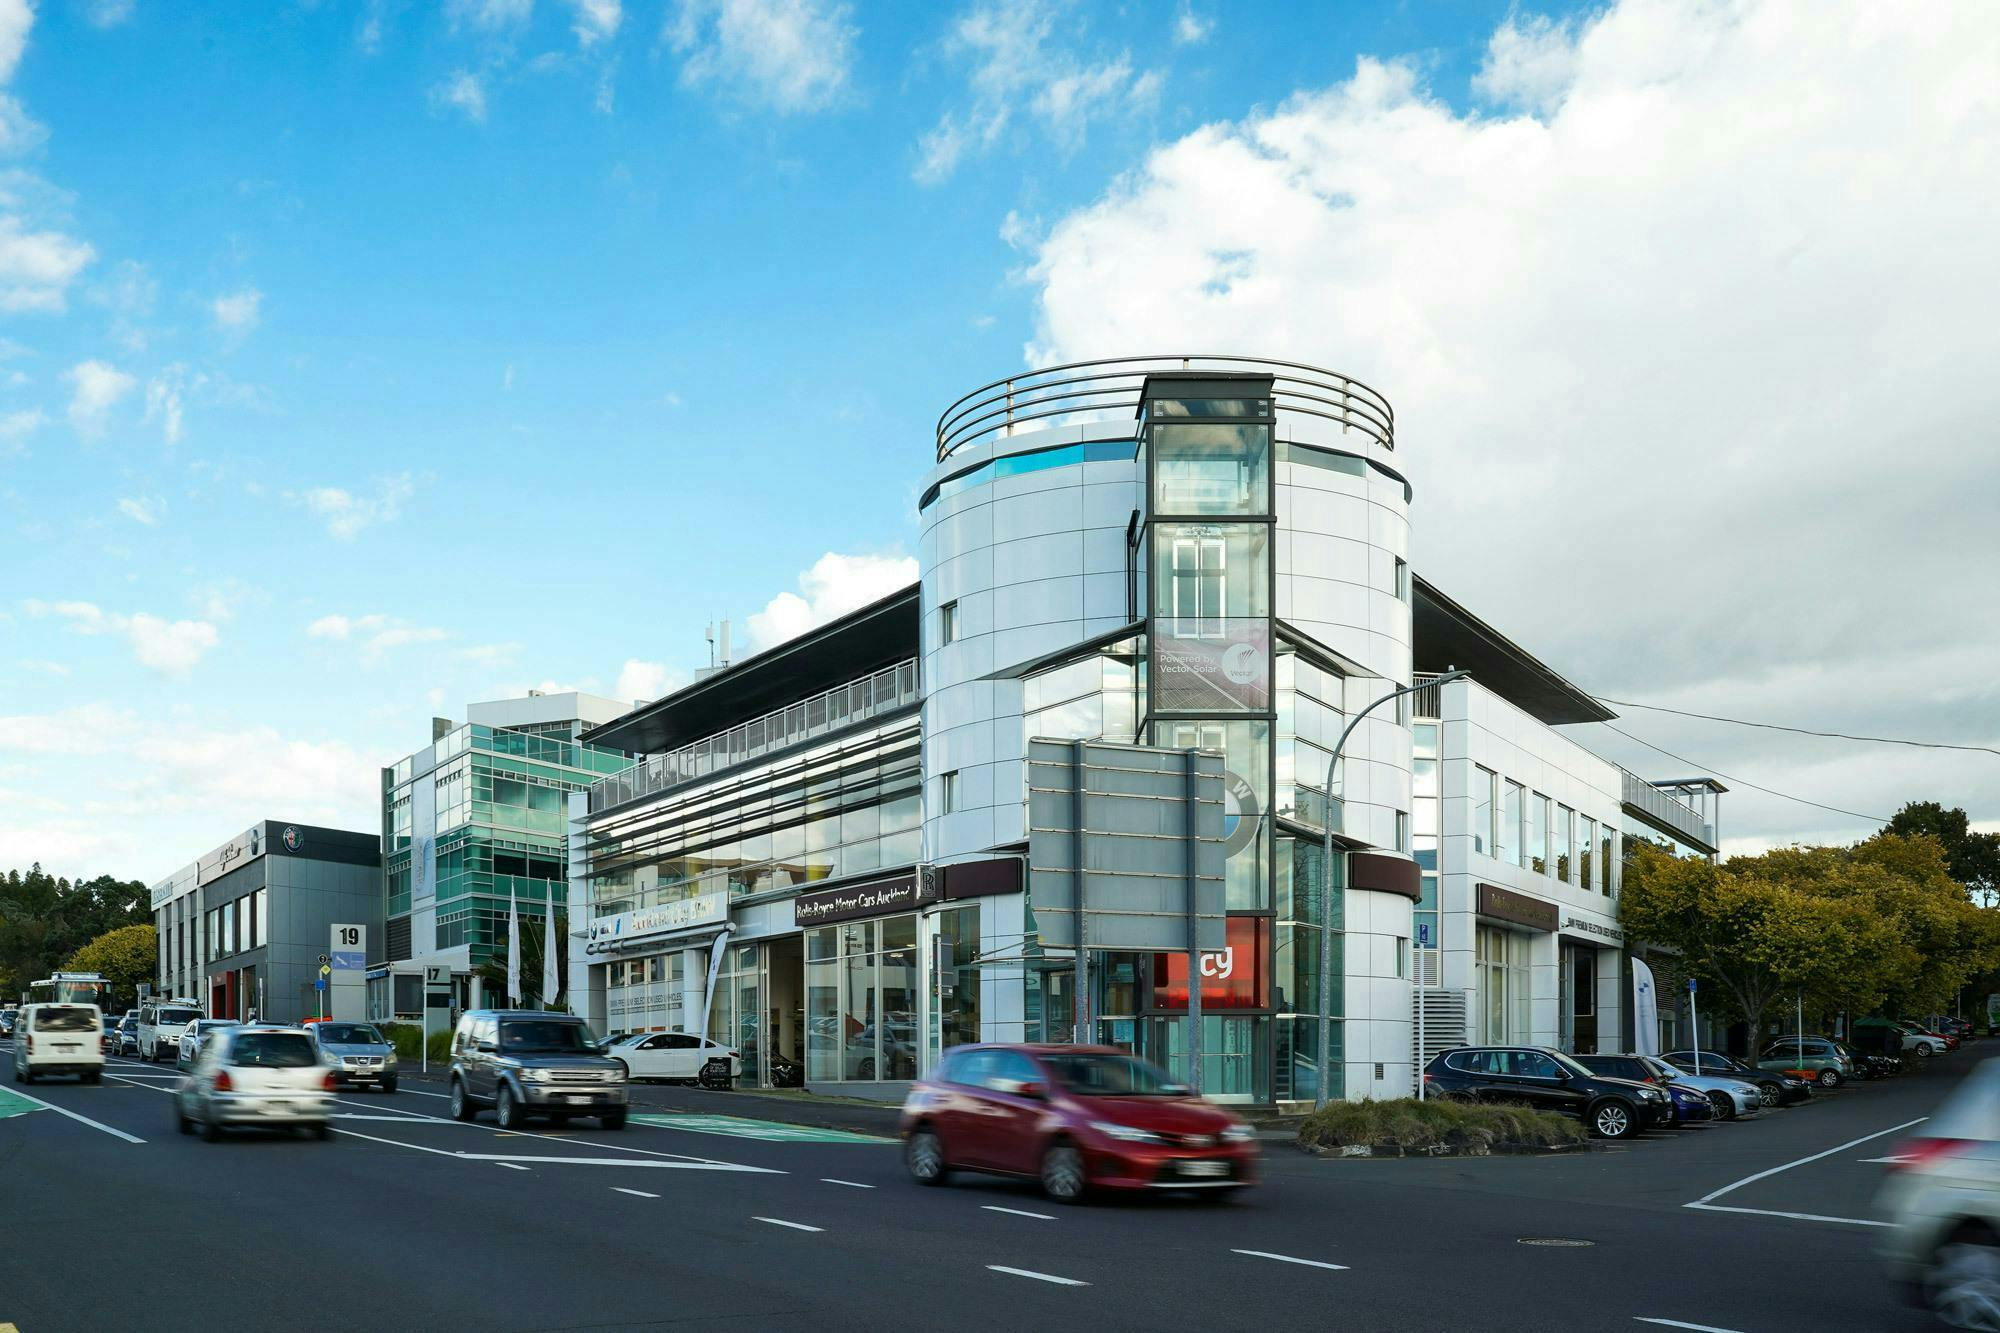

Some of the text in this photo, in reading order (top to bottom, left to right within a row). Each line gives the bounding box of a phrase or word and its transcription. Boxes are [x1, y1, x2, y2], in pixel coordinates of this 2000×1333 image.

[1160, 654, 1216, 664] Powered by
[1160, 664, 1217, 673] Vector Solar
[796, 885, 911, 919] Rolls-Royce Motor Cars Auckland
[339, 928, 359, 945] 19
[1200, 946, 1233, 979] cy
[427, 968, 440, 980] 17
